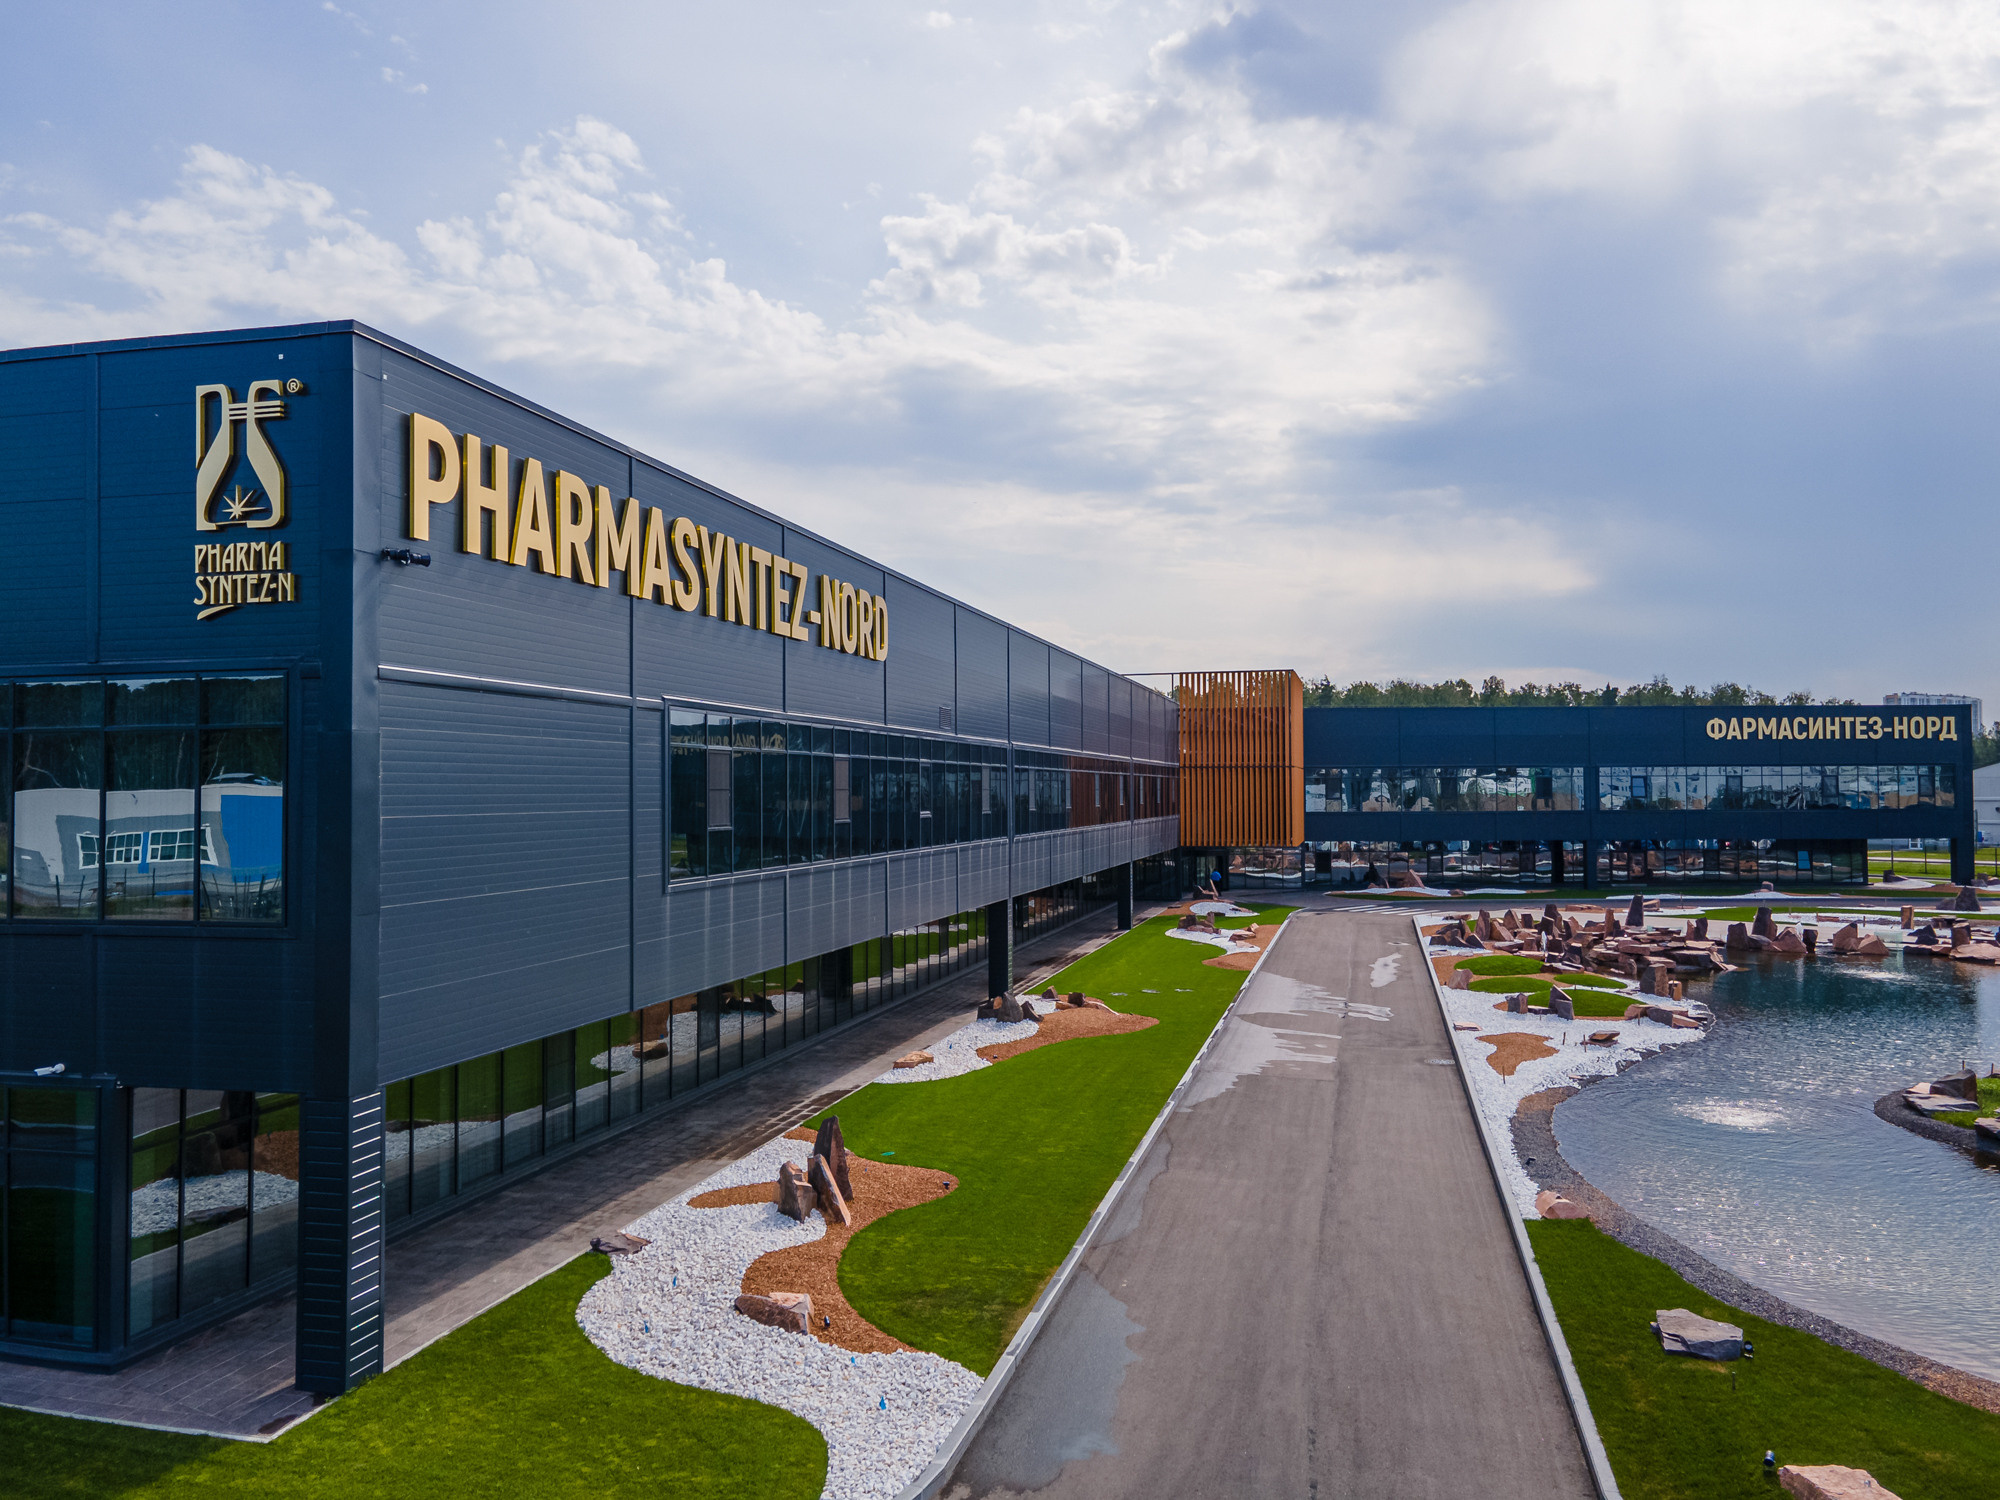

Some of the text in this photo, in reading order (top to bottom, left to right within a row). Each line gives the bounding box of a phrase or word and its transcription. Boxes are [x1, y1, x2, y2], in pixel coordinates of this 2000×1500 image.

[409, 412, 889, 662] PHARMASYNTEZ-NORD
[194, 541, 285, 574] PHARMA
[193, 572, 295, 606] SYNTEZ-N
[1706, 716, 1958, 741] ФАРМАСИНТЕЗ-НОРД
